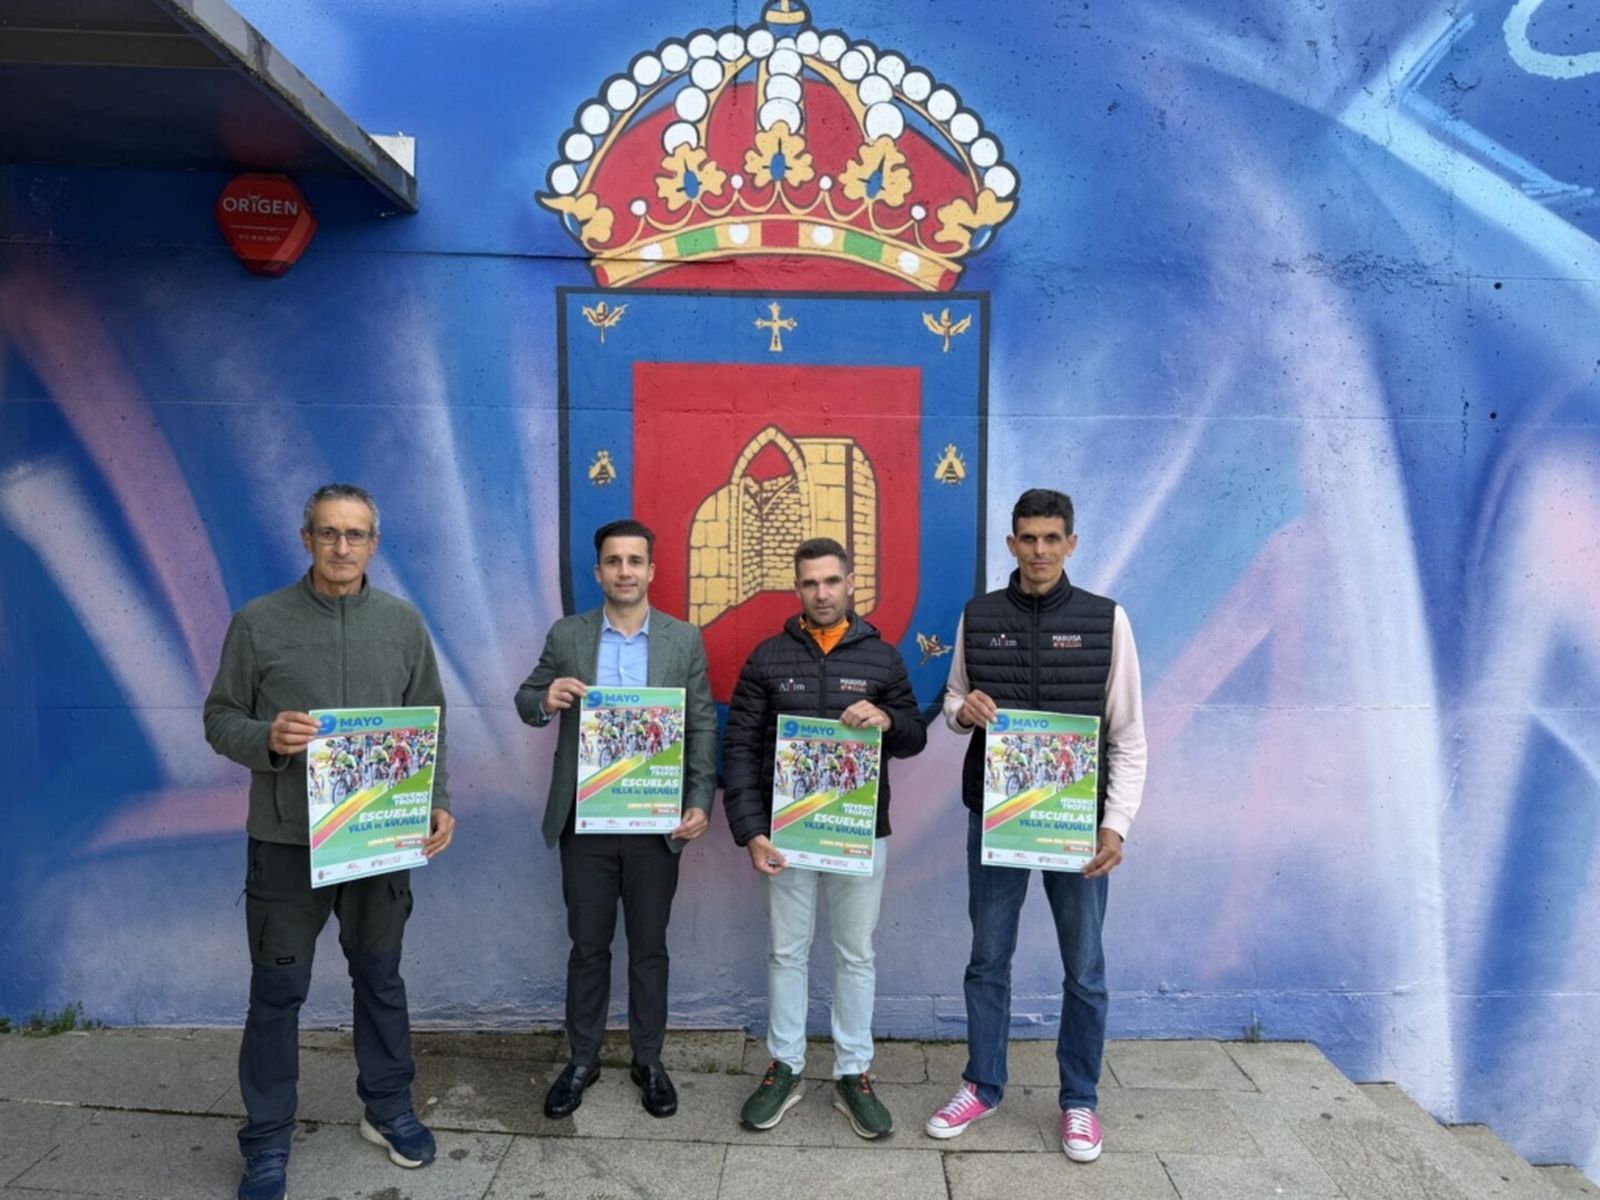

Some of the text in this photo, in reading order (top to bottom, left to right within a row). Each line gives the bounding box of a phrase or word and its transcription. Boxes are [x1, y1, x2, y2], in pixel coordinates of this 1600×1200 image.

[586, 690, 640, 708] 9 MAYO
[318, 714, 383, 735] 9 MAYO
[783, 720, 835, 738] 9 MAYO
[993, 714, 1049, 732] 9 MAYO
[621, 777, 680, 787] ESCUELAS
[358, 806, 428, 823] ESCUELAS
[813, 813, 873, 828] ESCUELAS
[1029, 810, 1093, 823] ESCUELAS
[348, 821, 373, 833] VILLA
[804, 821, 825, 831] VILLA
[1019, 819, 1042, 828] VILLA
